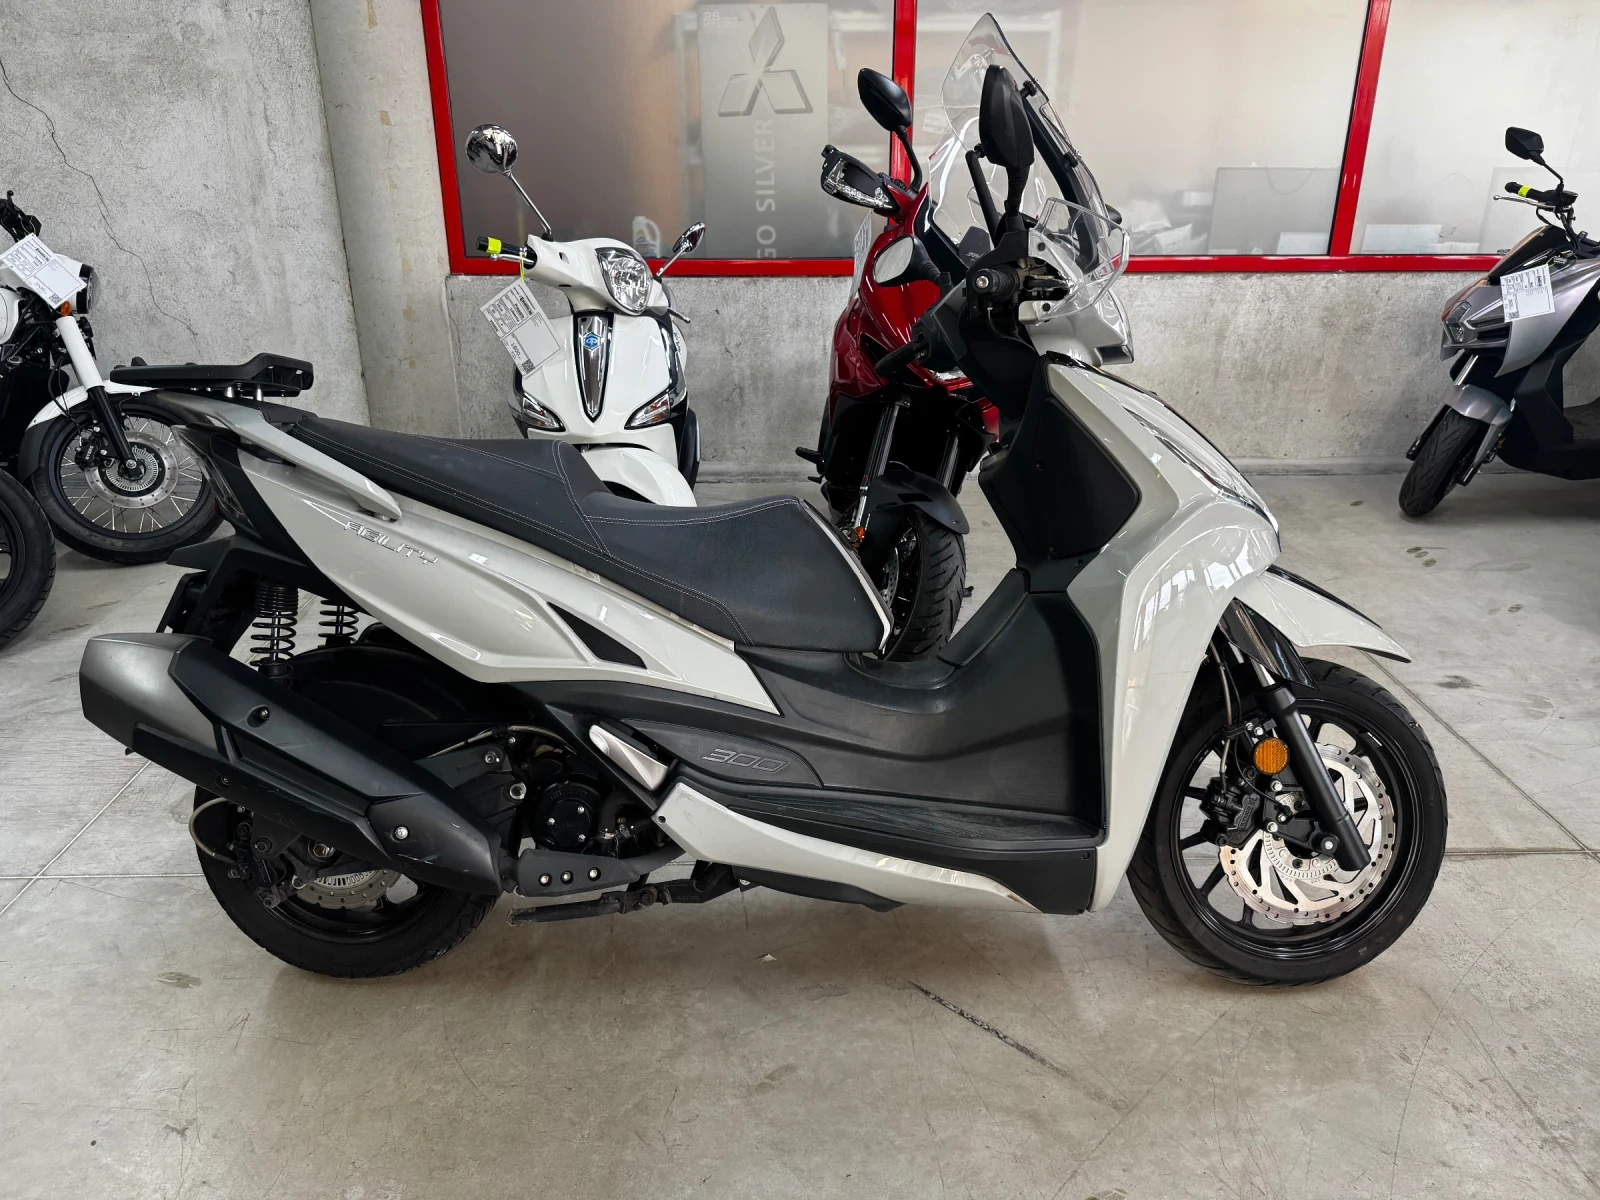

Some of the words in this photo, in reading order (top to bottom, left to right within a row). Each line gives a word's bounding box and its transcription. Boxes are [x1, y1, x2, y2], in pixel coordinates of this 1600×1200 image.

[754, 119, 776, 212] SILVER
[344, 520, 439, 564] AGILITY
[702, 748, 789, 773] 300
